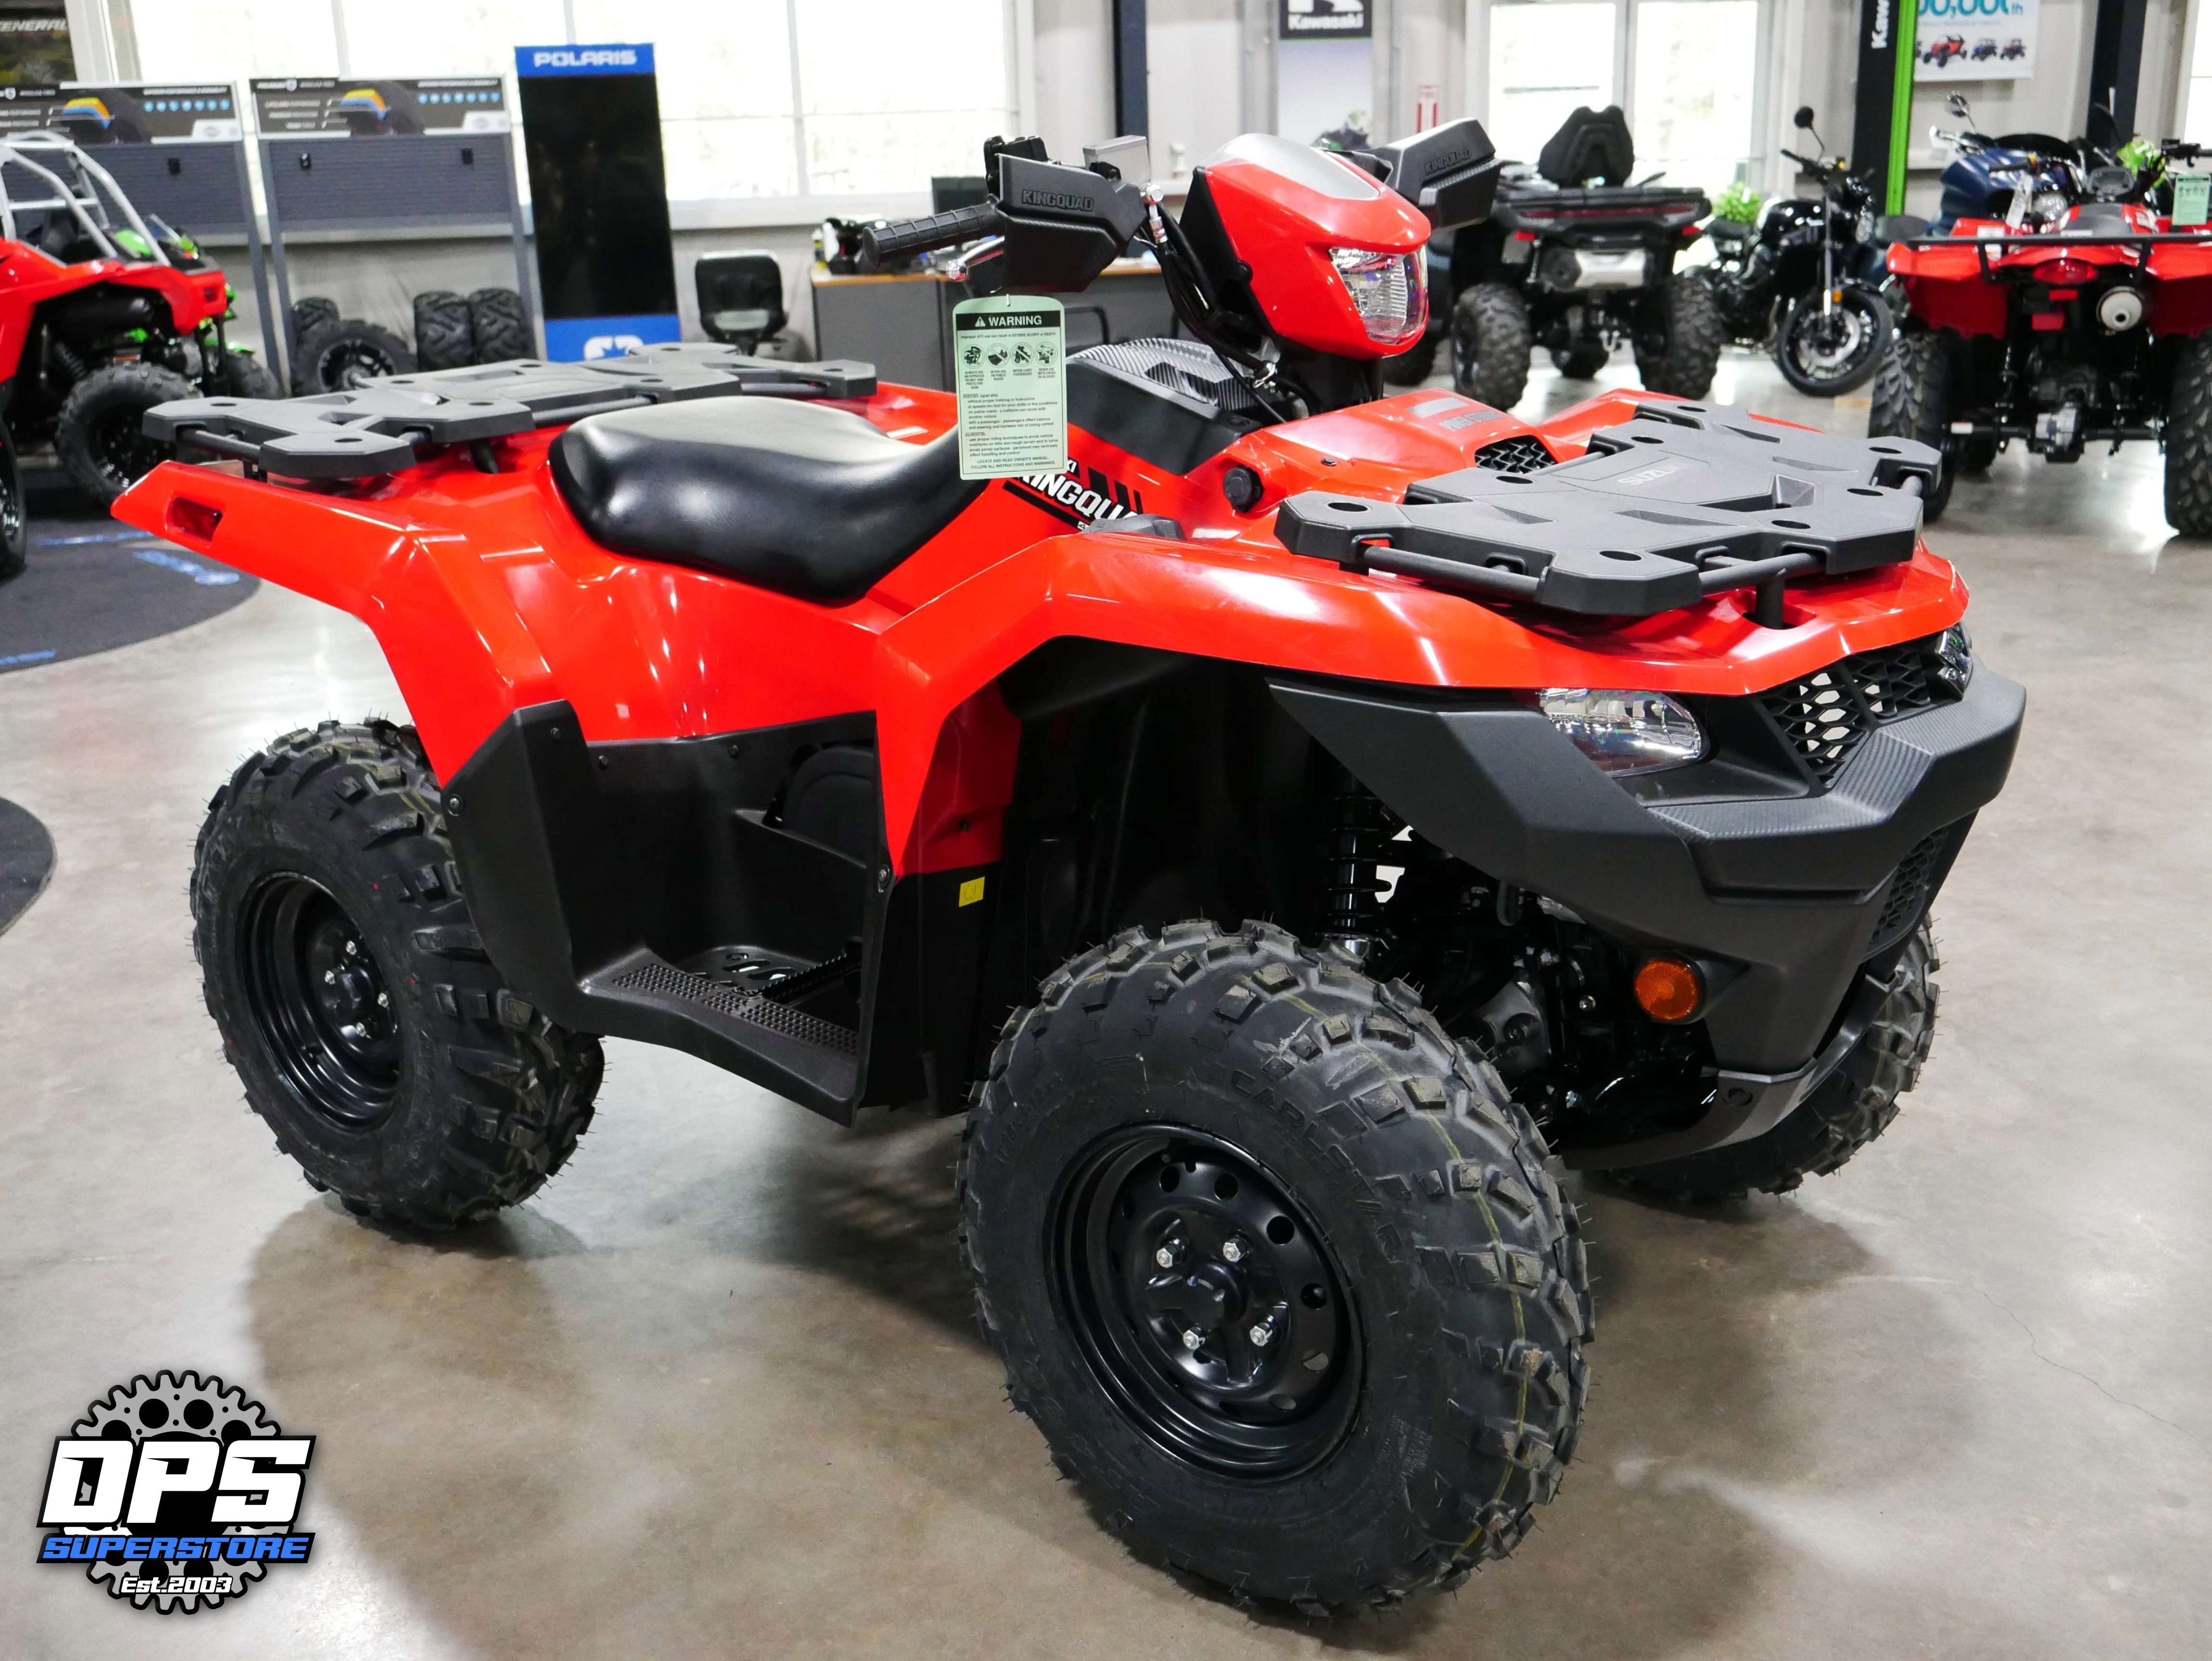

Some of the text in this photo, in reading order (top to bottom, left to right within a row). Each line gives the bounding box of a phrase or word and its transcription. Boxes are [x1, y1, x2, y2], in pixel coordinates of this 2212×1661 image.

[533, 50, 637, 67] POLARIS
[1424, 147, 1472, 175] KINGQUAD
[1022, 190, 1094, 211] KINGQUAD
[988, 316, 1042, 327] WARNING
